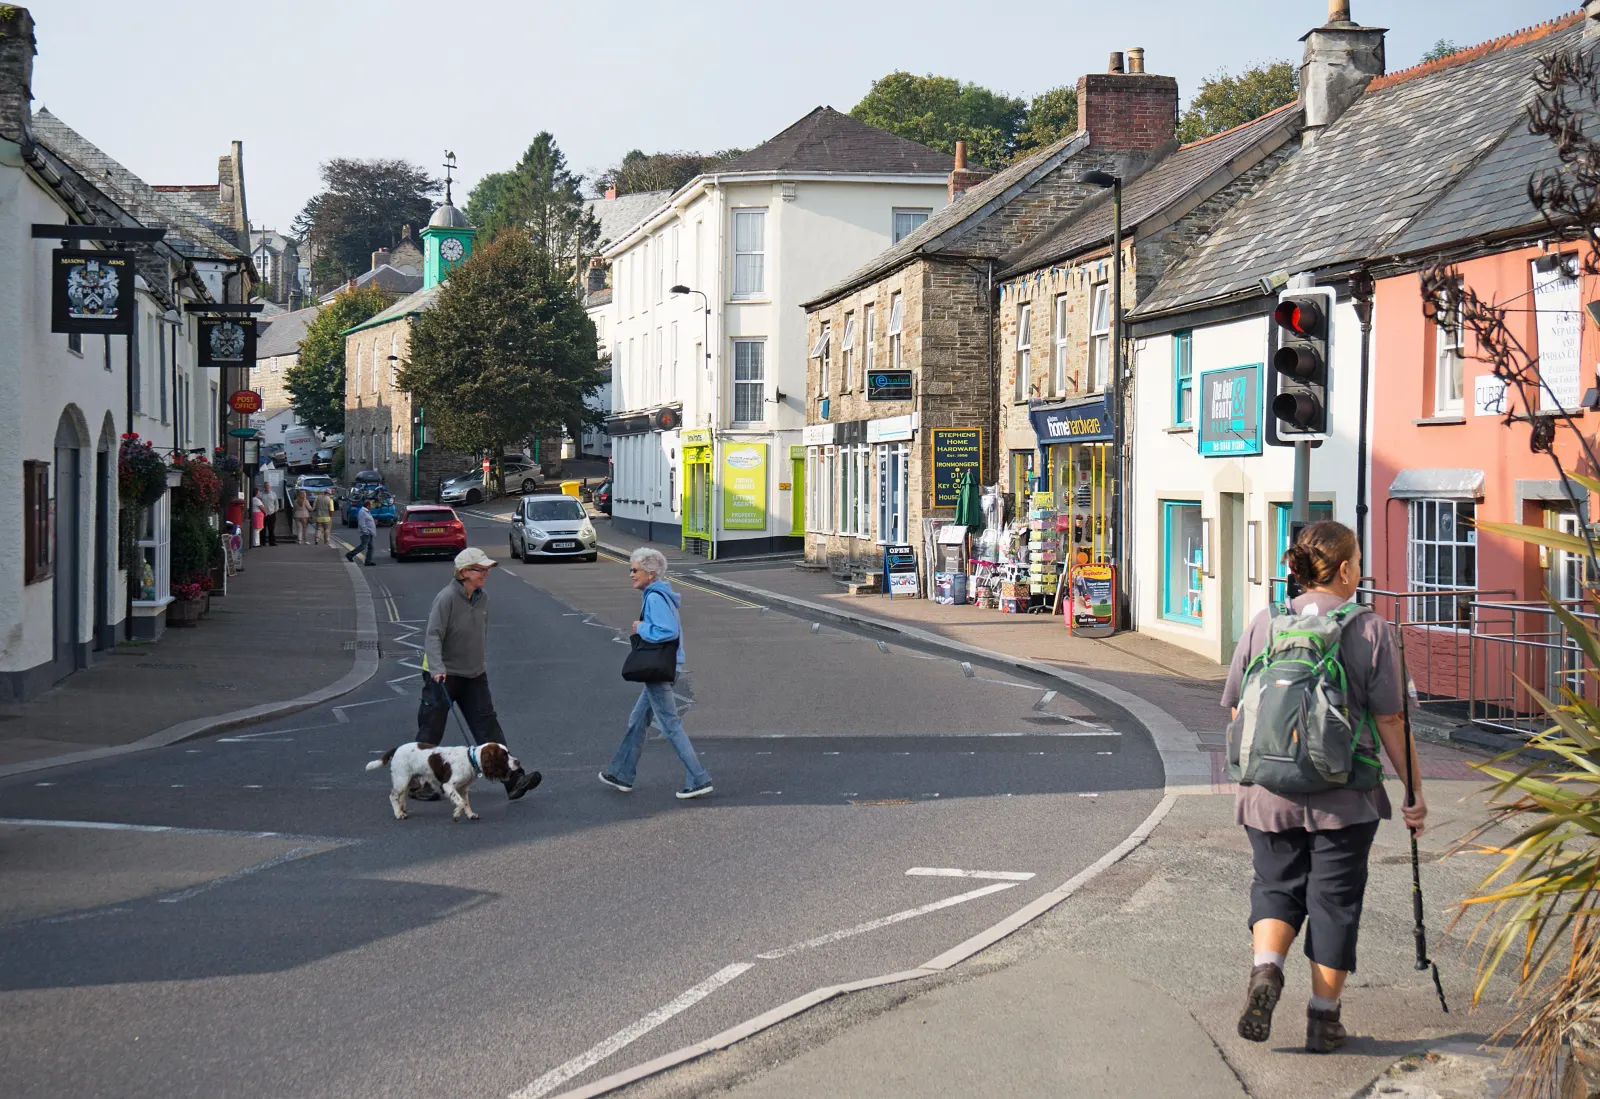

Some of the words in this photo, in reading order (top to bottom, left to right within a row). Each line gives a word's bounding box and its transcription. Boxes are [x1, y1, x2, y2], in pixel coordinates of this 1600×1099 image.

[1542, 351, 1566, 361] INDIAN
[1213, 381, 1222, 400] The
[1222, 378, 1233, 399] Hair
[1233, 379, 1244, 415] &
[1476, 385, 1505, 405] CURRY
[234, 402, 257, 410] OFFICE
[1212, 398, 1232, 420] Beauty
